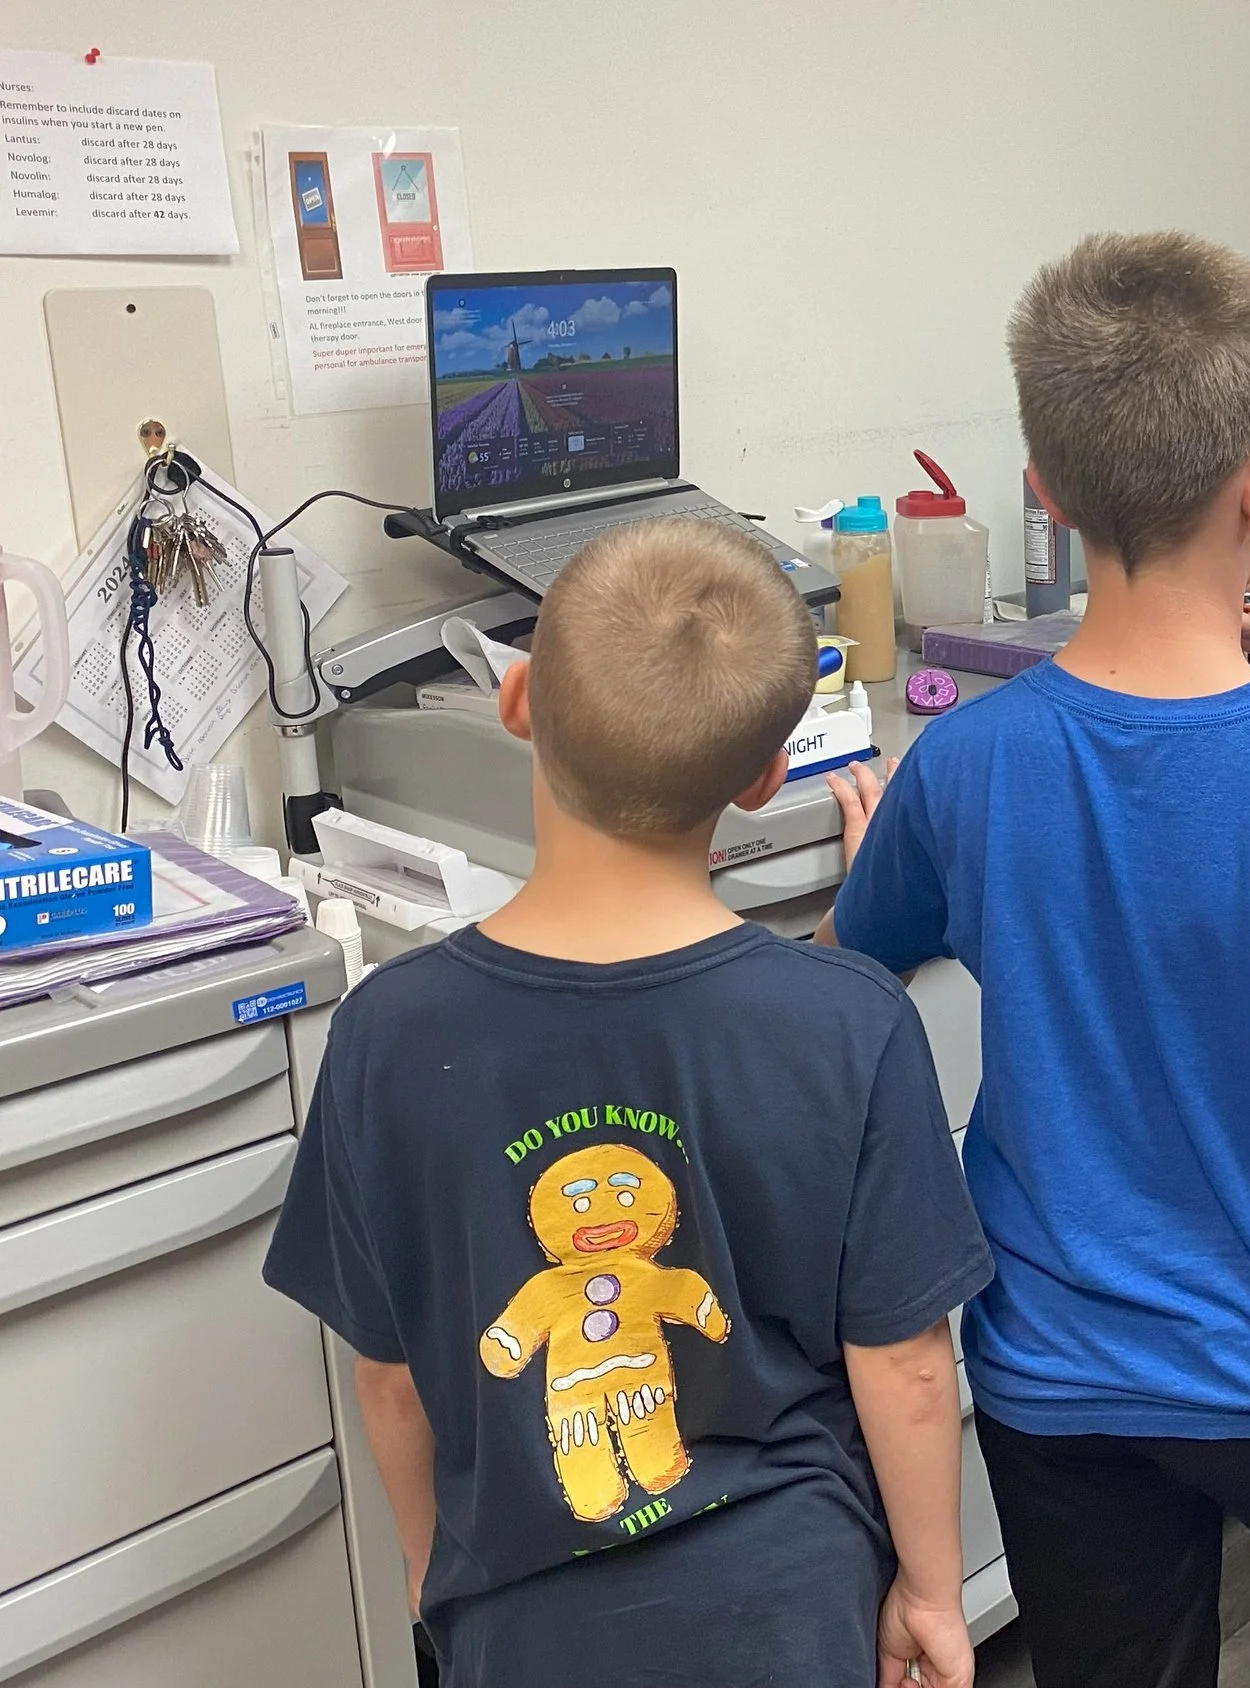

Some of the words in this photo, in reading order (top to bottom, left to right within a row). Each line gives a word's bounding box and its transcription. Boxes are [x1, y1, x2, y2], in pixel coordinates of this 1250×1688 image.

[0, 100, 54, 112] Remember
[56, 104, 67, 113] to
[69, 104, 104, 115] include
[106, 106, 140, 117] discard
[142, 108, 167, 119] dates
[169, 111, 181, 119] on
[1, 115, 39, 126] insulins
[41, 117, 69, 128] when
[71, 120, 89, 130] you
[90, 121, 113, 130] start
[123, 124, 143, 132] new
[145, 125, 166, 133] pen.
[4, 134, 40, 144] Lantus:
[81, 137, 115, 148] discard
[117, 139, 140, 149] after
[142, 140, 154, 149] 28
[156, 141, 178, 151] days
[7, 152, 51, 164] Novolog:
[83, 155, 118, 165] discard
[120, 157, 143, 166] after
[145, 158, 157, 167] 28
[159, 158, 181, 168] days
[10, 171, 52, 181] Novolin:
[86, 174, 121, 183] discard
[123, 174, 146, 184] after
[148, 175, 160, 184] 28
[162, 176, 183, 186] days
[13, 189, 60, 201] Humalog:
[89, 191, 123, 201] discard
[126, 192, 148, 201] after
[150, 193, 162, 202] 28
[164, 193, 186, 204] days
[15, 207, 59, 217] Levemir:
[92, 209, 126, 218] discard
[128, 209, 151, 219] after
[153, 210, 166, 219] 42
[167, 210, 191, 221] days.
[305, 293, 326, 303] Don't
[327, 293, 349, 303] forget
[351, 293, 360, 301] to
[360, 293, 378, 301] open
[380, 291, 392, 299] the
[392, 290, 412, 298] doors
[309, 322, 319, 330] AL
[320, 321, 352, 331] fireplace
[353, 320, 386, 328] entrance,
[387, 318, 405, 326] West
[547, 320, 576, 338] 4:03
[310, 334, 340, 342] therapy
[340, 333, 360, 341] door.
[312, 350, 334, 358] Super
[335, 348, 357, 357] duper
[358, 346, 393, 355] important
[394, 344, 404, 352] for
[314, 361, 345, 371] personal
[347, 360, 357, 368] for
[359, 357, 397, 366] ambulance
[97, 556, 131, 603] 2024
[783, 733, 828, 757] NIGHT
[727, 845, 741, 854] OPEN
[741, 841, 755, 850] ONLY
[756, 837, 766, 846] ONE
[727, 849, 749, 861] DRAWER
[749, 847, 757, 855] AT
[761, 843, 773, 851] TIME
[709, 848, 727, 865] ION!
[0, 860, 133, 901] ITRILECARE
[112, 903, 135, 917] 100
[504, 1128, 544, 1165] DO
[545, 1106, 599, 1140] YOU
[619, 1497, 673, 1537] THE
